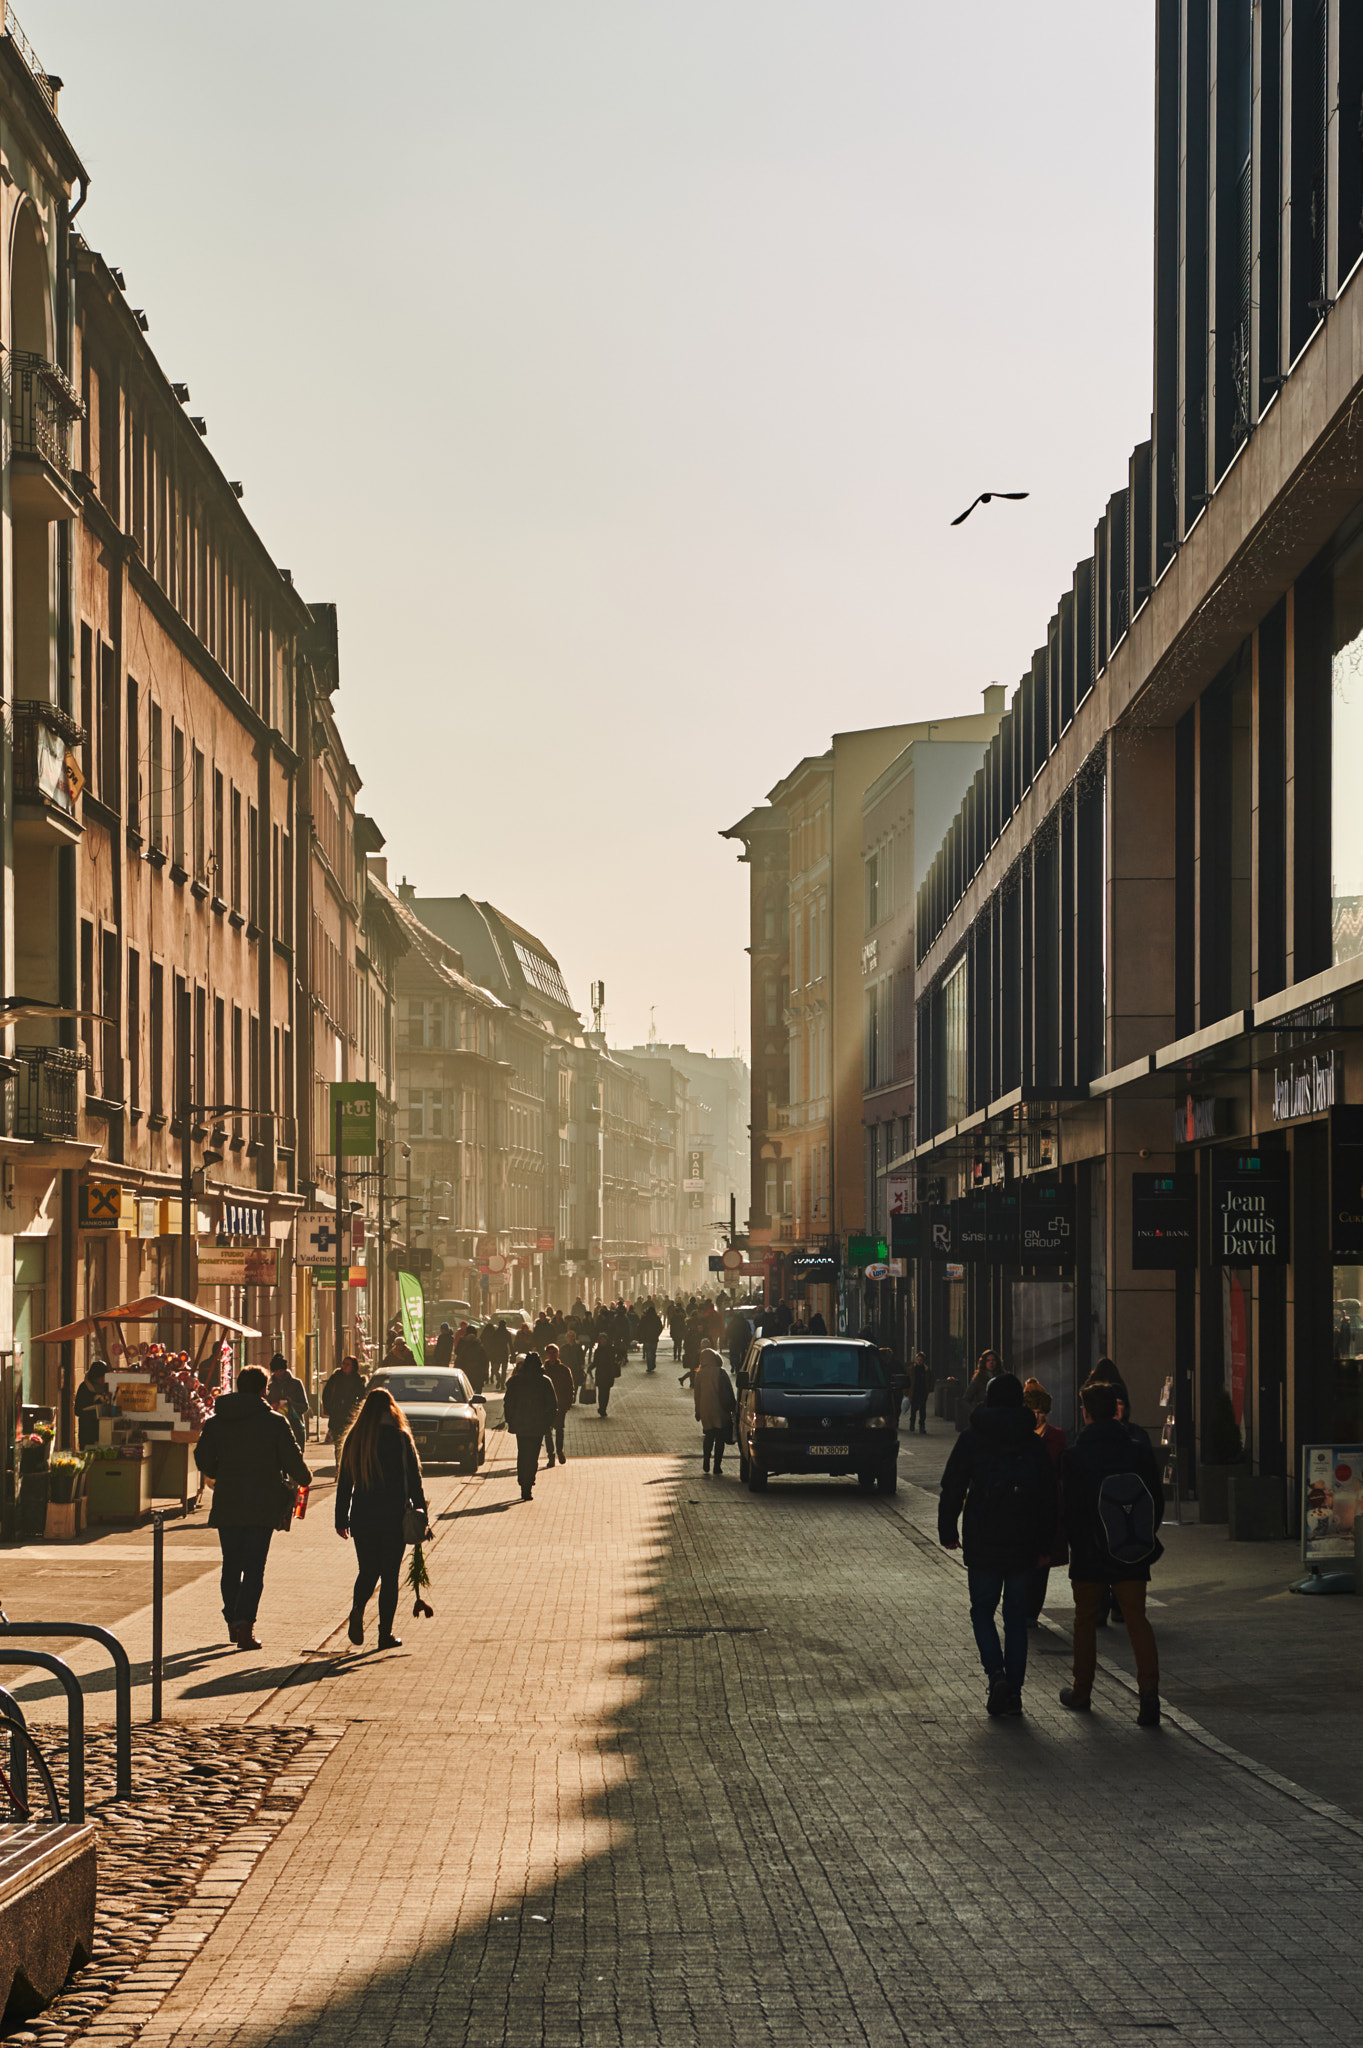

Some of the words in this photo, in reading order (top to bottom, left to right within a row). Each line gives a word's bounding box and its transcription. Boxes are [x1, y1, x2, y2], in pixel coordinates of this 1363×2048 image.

[1221, 1191, 1265, 1212] Jean
[223, 1203, 266, 1236] APTEKA
[1223, 1213, 1275, 1234] Louis
[1024, 1230, 1040, 1239] GN
[1024, 1239, 1061, 1248] GROUP
[1223, 1234, 1276, 1255] David
[300, 1254, 348, 1263] Vademecm
